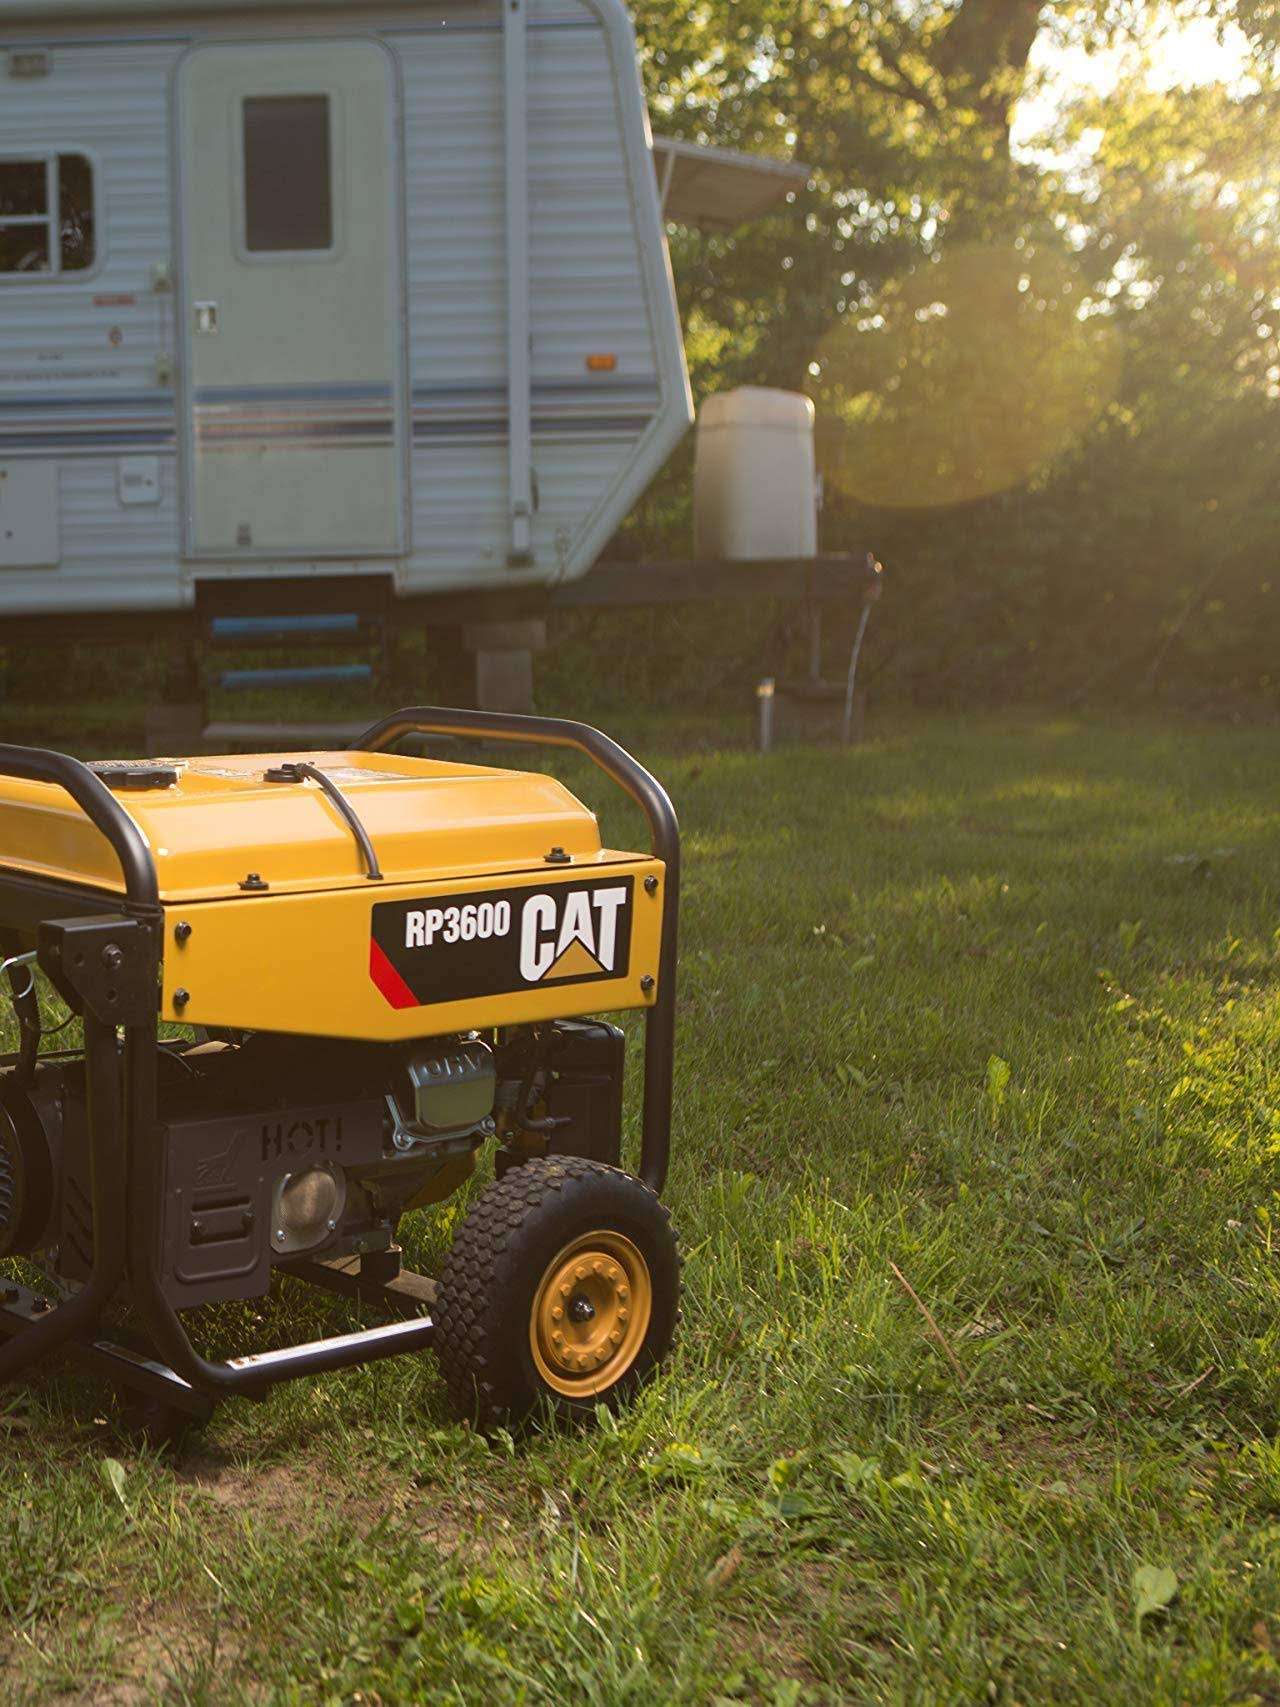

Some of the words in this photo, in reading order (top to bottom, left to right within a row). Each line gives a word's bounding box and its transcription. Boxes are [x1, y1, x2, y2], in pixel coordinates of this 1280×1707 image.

[405, 900, 511, 948] RP3600
[520, 887, 627, 982] CAT
[261, 1117, 343, 1161] HOT!
